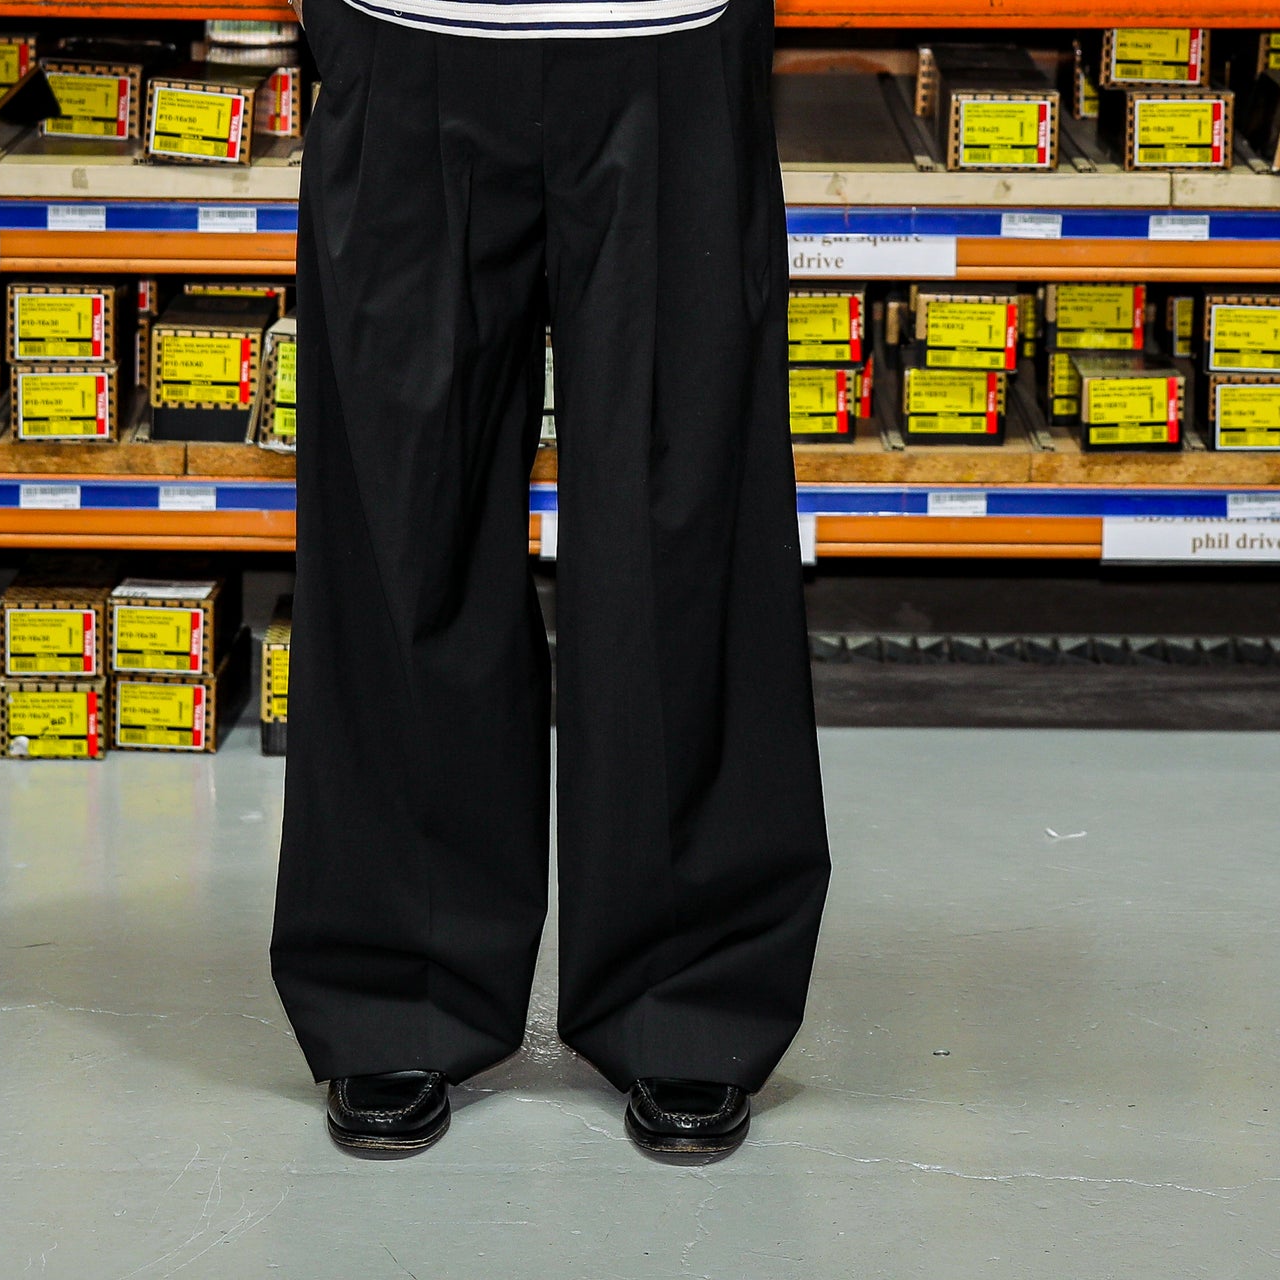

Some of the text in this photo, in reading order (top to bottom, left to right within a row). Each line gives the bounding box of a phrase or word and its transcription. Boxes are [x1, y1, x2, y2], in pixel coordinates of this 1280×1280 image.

[230, 115, 239, 142] METAL
[1039, 121, 1047, 147] METAL
[1213, 119, 1222, 147] METAL
[793, 252, 844, 268] drive
[94, 314, 102, 341] METAL
[98, 392, 106, 420] METAL
[1191, 533, 1229, 554] phil
